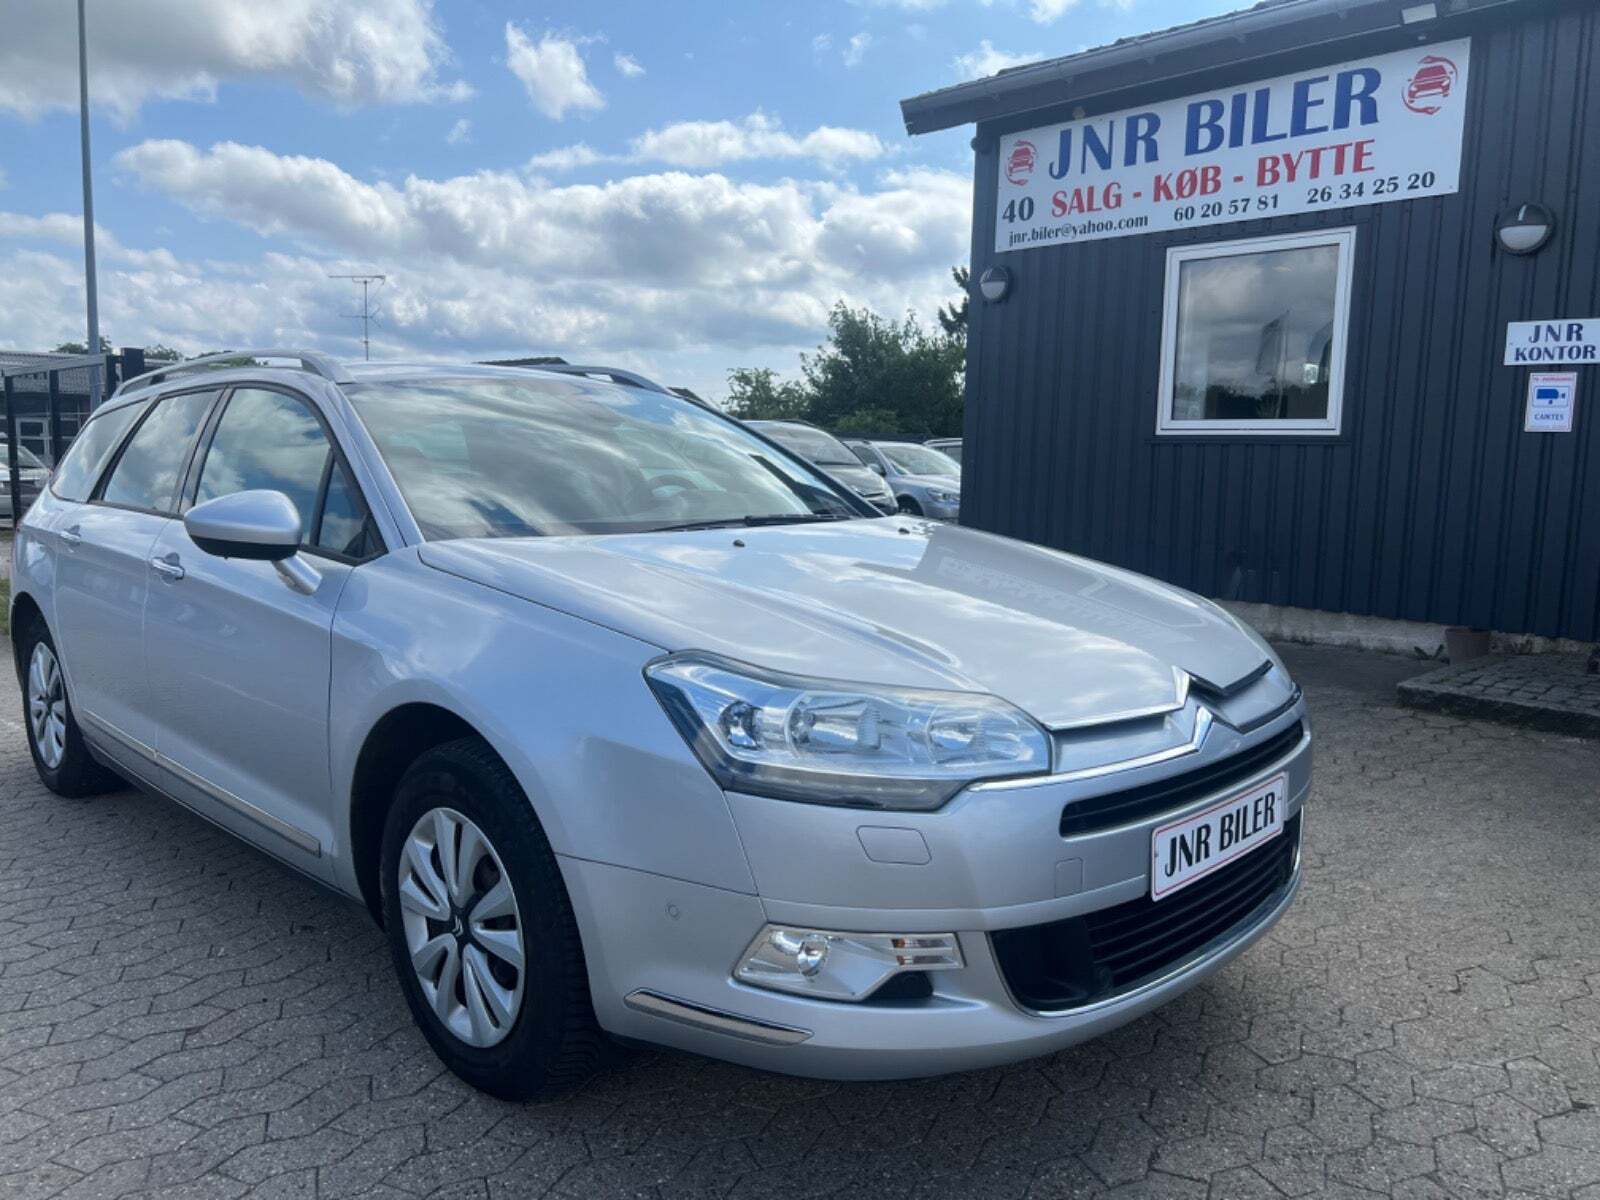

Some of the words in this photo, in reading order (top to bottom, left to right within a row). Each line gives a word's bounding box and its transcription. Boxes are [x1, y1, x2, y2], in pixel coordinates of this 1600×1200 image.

[1049, 112, 1161, 180] JNR
[1184, 67, 1382, 157] BILER
[1051, 182, 1122, 218] SALG
[1153, 165, 1222, 203] KØB
[1256, 138, 1375, 187] BYTTE
[1307, 185, 1332, 204] 26
[1339, 182, 1364, 200] 34
[1372, 176, 1399, 195] 25
[1407, 171, 1435, 190] 20
[1002, 196, 1034, 223] 40
[1174, 205, 1195, 221] 60
[1200, 201, 1222, 218] 20
[1228, 198, 1251, 214] 57
[1256, 194, 1279, 211] 81
[1009, 215, 1149, 247] jnr.biler@yahoo.com
[1528, 323, 1584, 343] JNR
[1514, 344, 1597, 362] KONTOR
[1165, 823, 1211, 877] JNR
[1219, 791, 1276, 852] BILER
